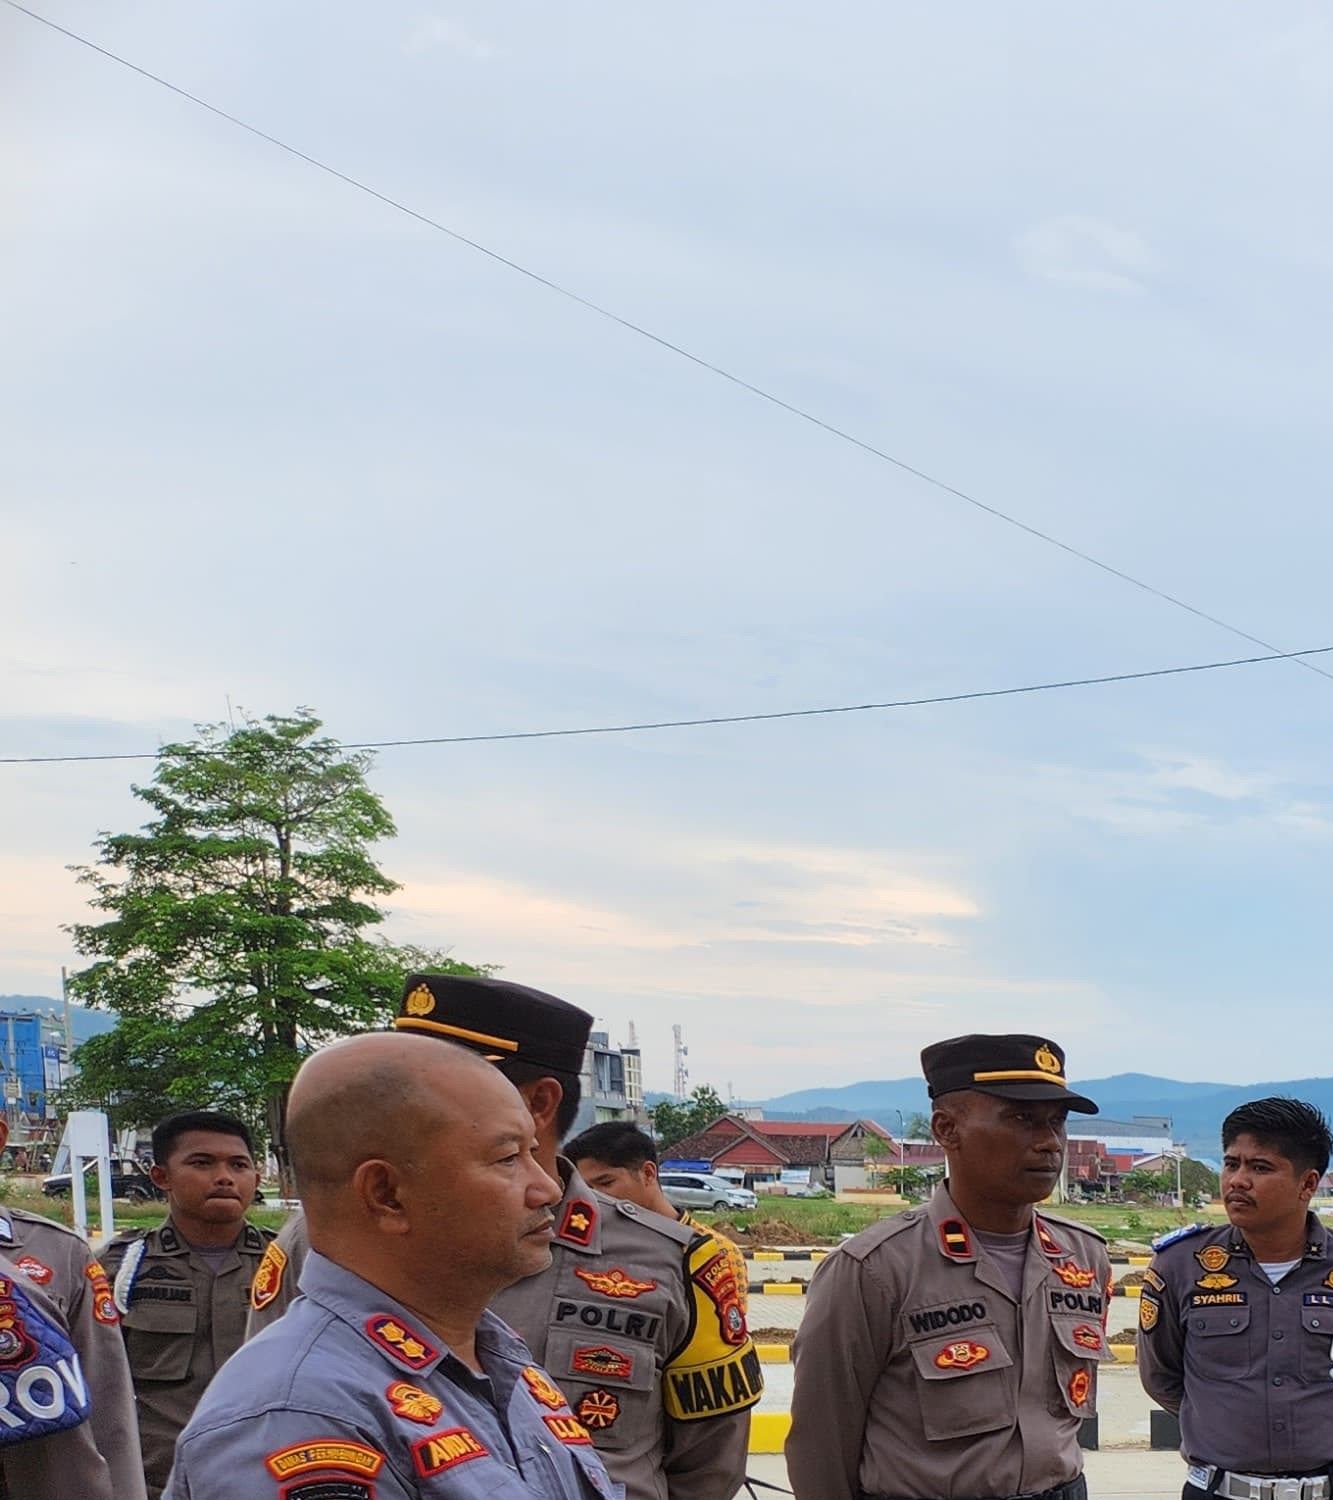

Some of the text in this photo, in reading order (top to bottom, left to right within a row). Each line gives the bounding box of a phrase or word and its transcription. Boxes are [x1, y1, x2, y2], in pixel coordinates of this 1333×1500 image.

[1051, 1291, 1102, 1315] POLRI
[1193, 1293, 1244, 1305] SYAHRIL
[556, 1302, 659, 1339] POLRI
[909, 1302, 986, 1334] WIDODO
